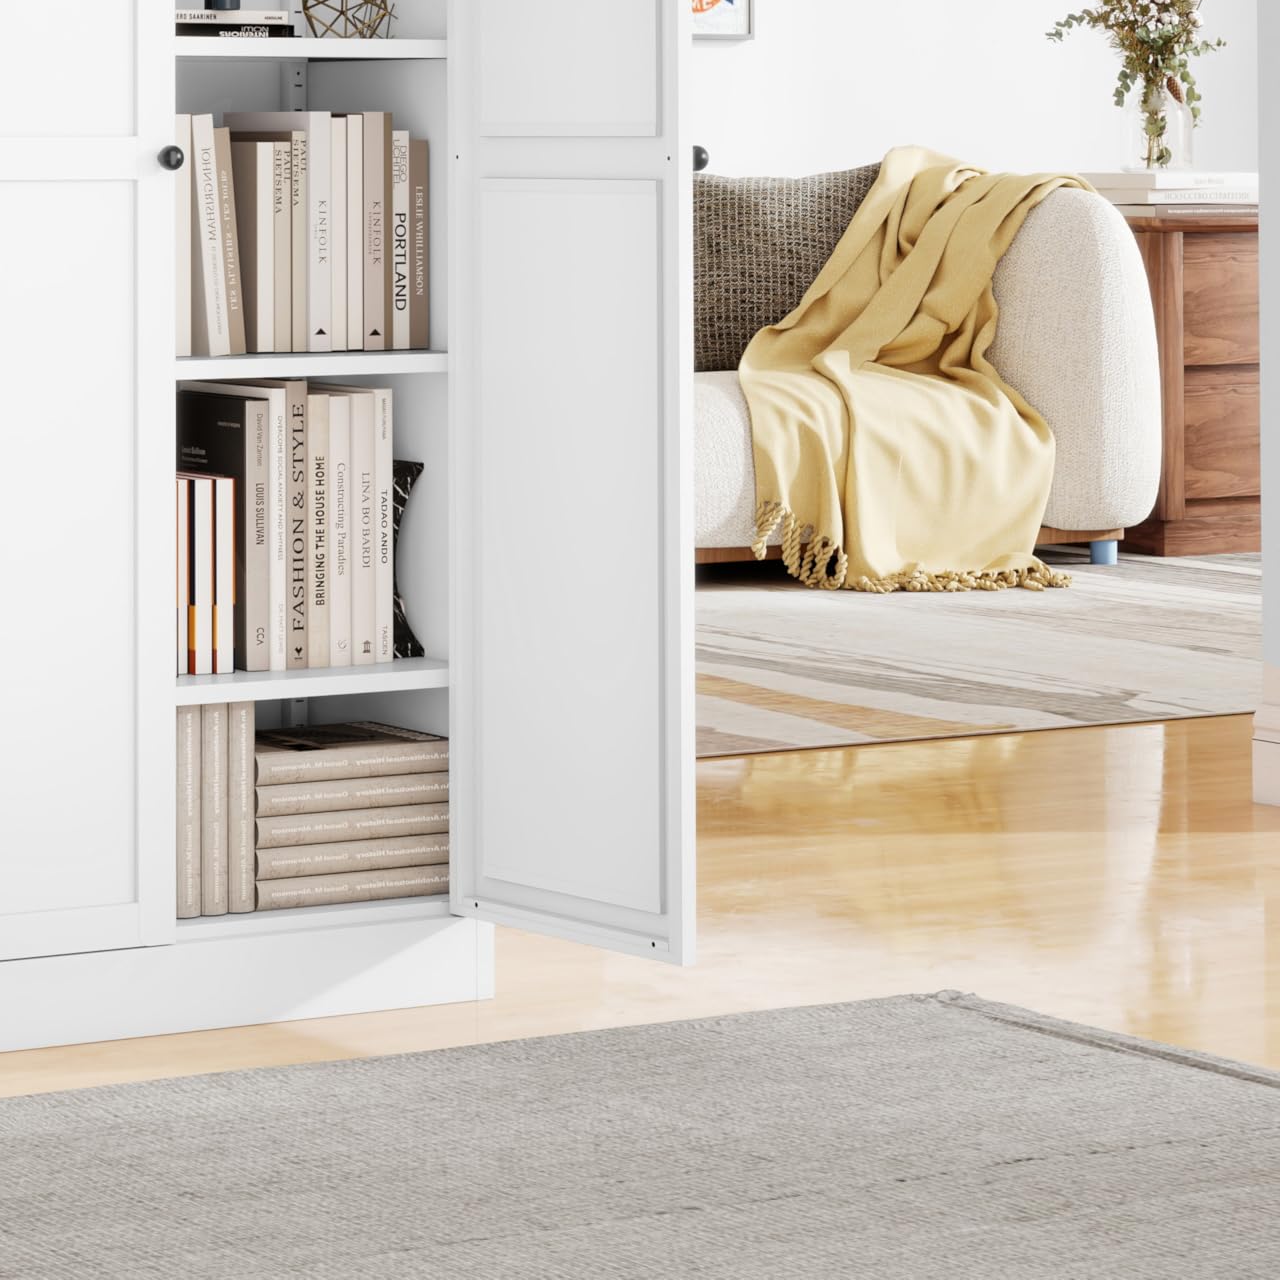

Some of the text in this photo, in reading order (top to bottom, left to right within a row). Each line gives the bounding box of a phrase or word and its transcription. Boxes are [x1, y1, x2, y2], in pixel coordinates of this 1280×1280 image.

[275, 149, 283, 214] SIETSEMA
[283, 150, 291, 183] PAUL
[292, 139, 300, 207] SIETSEMA
[393, 139, 401, 189] UCHITEL
[400, 144, 408, 182] DIEGO
[318, 200, 327, 265] KINFOLK
[372, 201, 381, 265] KINFOLK
[394, 212, 407, 311] PORTLAND
[415, 185, 424, 296] LESLIE WHILLIAMSON
[256, 413, 264, 431] David
[256, 431, 264, 443] Van
[256, 483, 265, 545] LOUIS SULLIVAN
[292, 404, 305, 632] FASHION & STYLE
[335, 462, 347, 529] Constructing
[362, 472, 371, 569] LINA BO BARDI
[381, 490, 389, 564] TADAO ANDO
[315, 456, 325, 606] BRINGING THE HOUSE HOME
[256, 627, 265, 646] CCA
